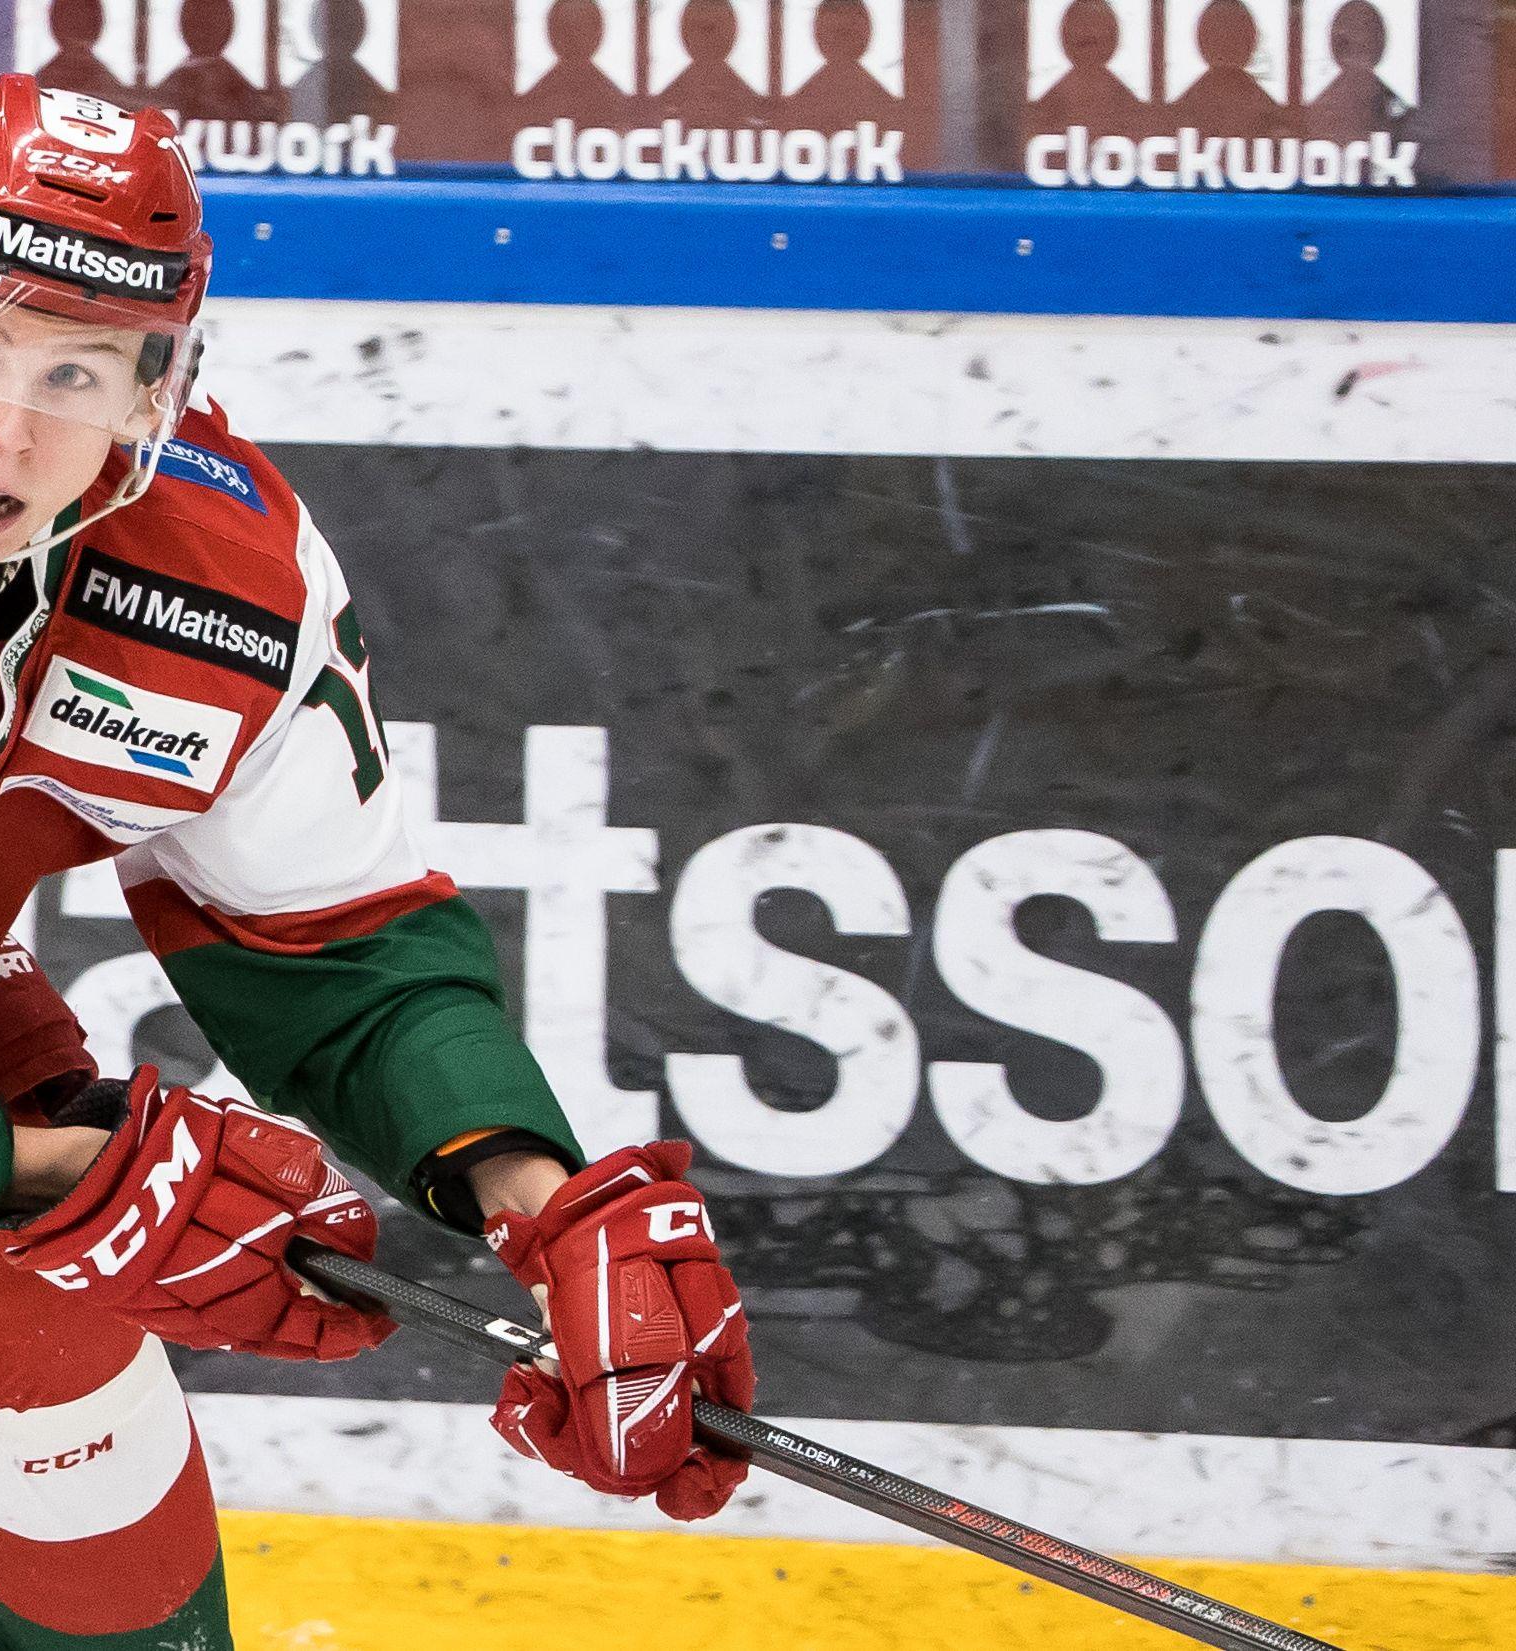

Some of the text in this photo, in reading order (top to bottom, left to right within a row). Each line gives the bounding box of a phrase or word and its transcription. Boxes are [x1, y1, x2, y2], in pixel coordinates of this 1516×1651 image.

[26, 148, 133, 185] CCM
[161, 108, 399, 176] kwork
[513, 118, 904, 184] clockwork
[1024, 124, 1418, 190] clockwork
[84, 568, 287, 670] FM Mattsson
[50, 695, 210, 763] dalakraft
[35, 1116, 202, 1291] CCM
[325, 1207, 368, 1225] CC
[23, 1432, 114, 1475] CCM
[767, 1430, 840, 1468] HELLDEN
